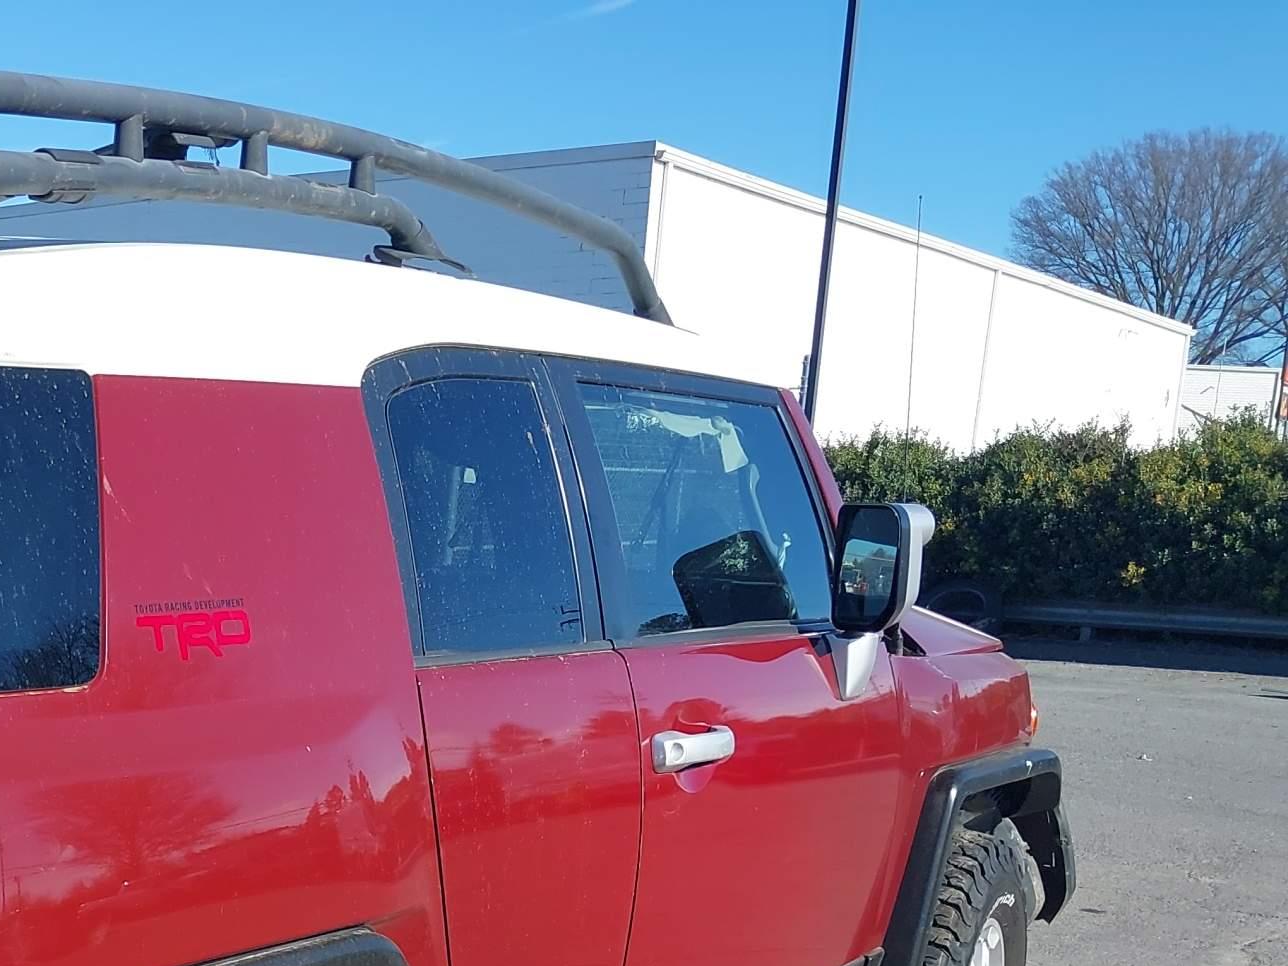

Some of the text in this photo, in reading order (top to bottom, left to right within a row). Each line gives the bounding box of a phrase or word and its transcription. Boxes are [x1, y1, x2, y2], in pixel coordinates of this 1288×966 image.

[134, 598, 244, 614] TOYOTA RACING DEVELOPMENT
[136, 610, 251, 661] TRD
